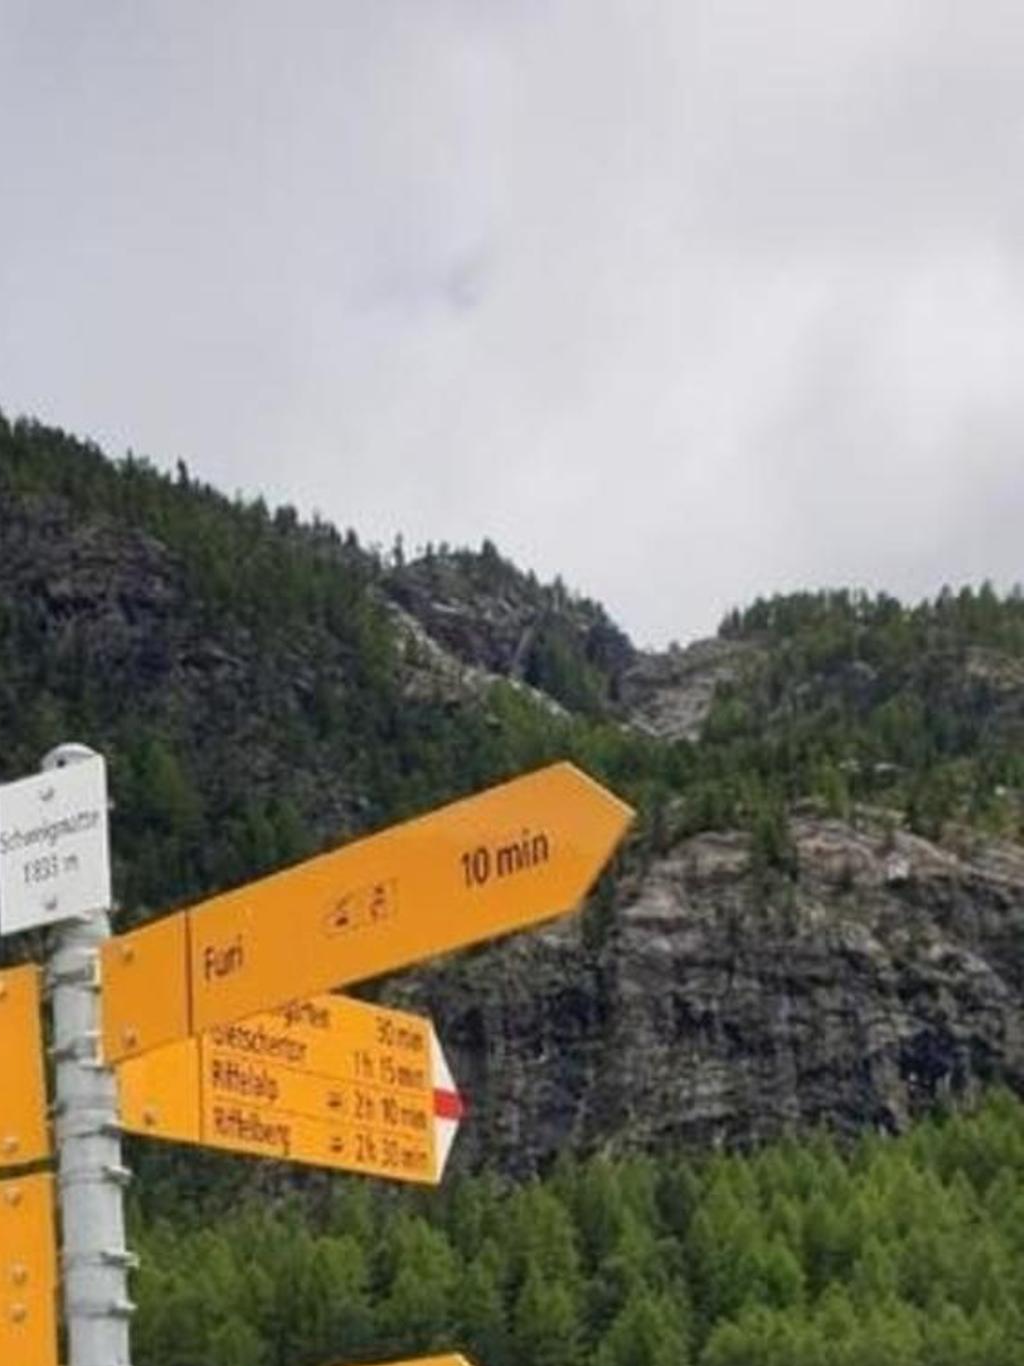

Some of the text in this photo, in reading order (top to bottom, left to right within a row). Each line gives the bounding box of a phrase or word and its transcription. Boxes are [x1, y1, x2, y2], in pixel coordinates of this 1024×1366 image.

[461, 828, 550, 889] 10 min
[204, 934, 244, 983] Furi
